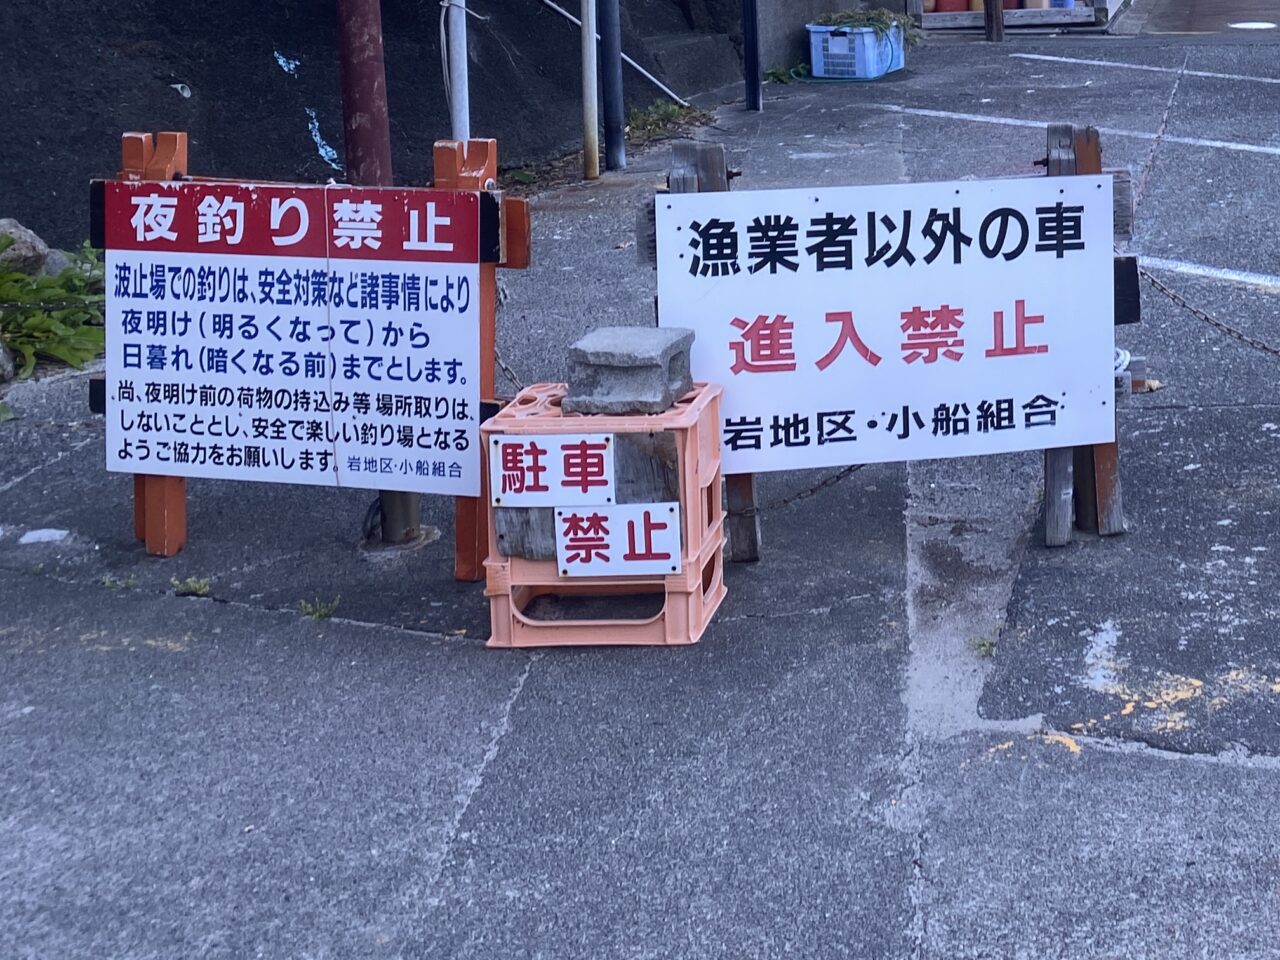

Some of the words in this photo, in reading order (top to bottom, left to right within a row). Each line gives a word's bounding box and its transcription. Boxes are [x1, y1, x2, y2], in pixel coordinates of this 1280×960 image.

[130, 193, 454, 252] 夜釣り禁止
[688, 201, 1086, 277] 漁業者以外の車
[114, 262, 470, 314] 波止場での釣りは、安全対策など諸事情により
[728, 299, 1049, 376] 進入禁止
[722, 394, 1060, 451] 岩地区・小船組合
[501, 440, 609, 494] 駐車
[562, 510, 671, 564] 禁止
